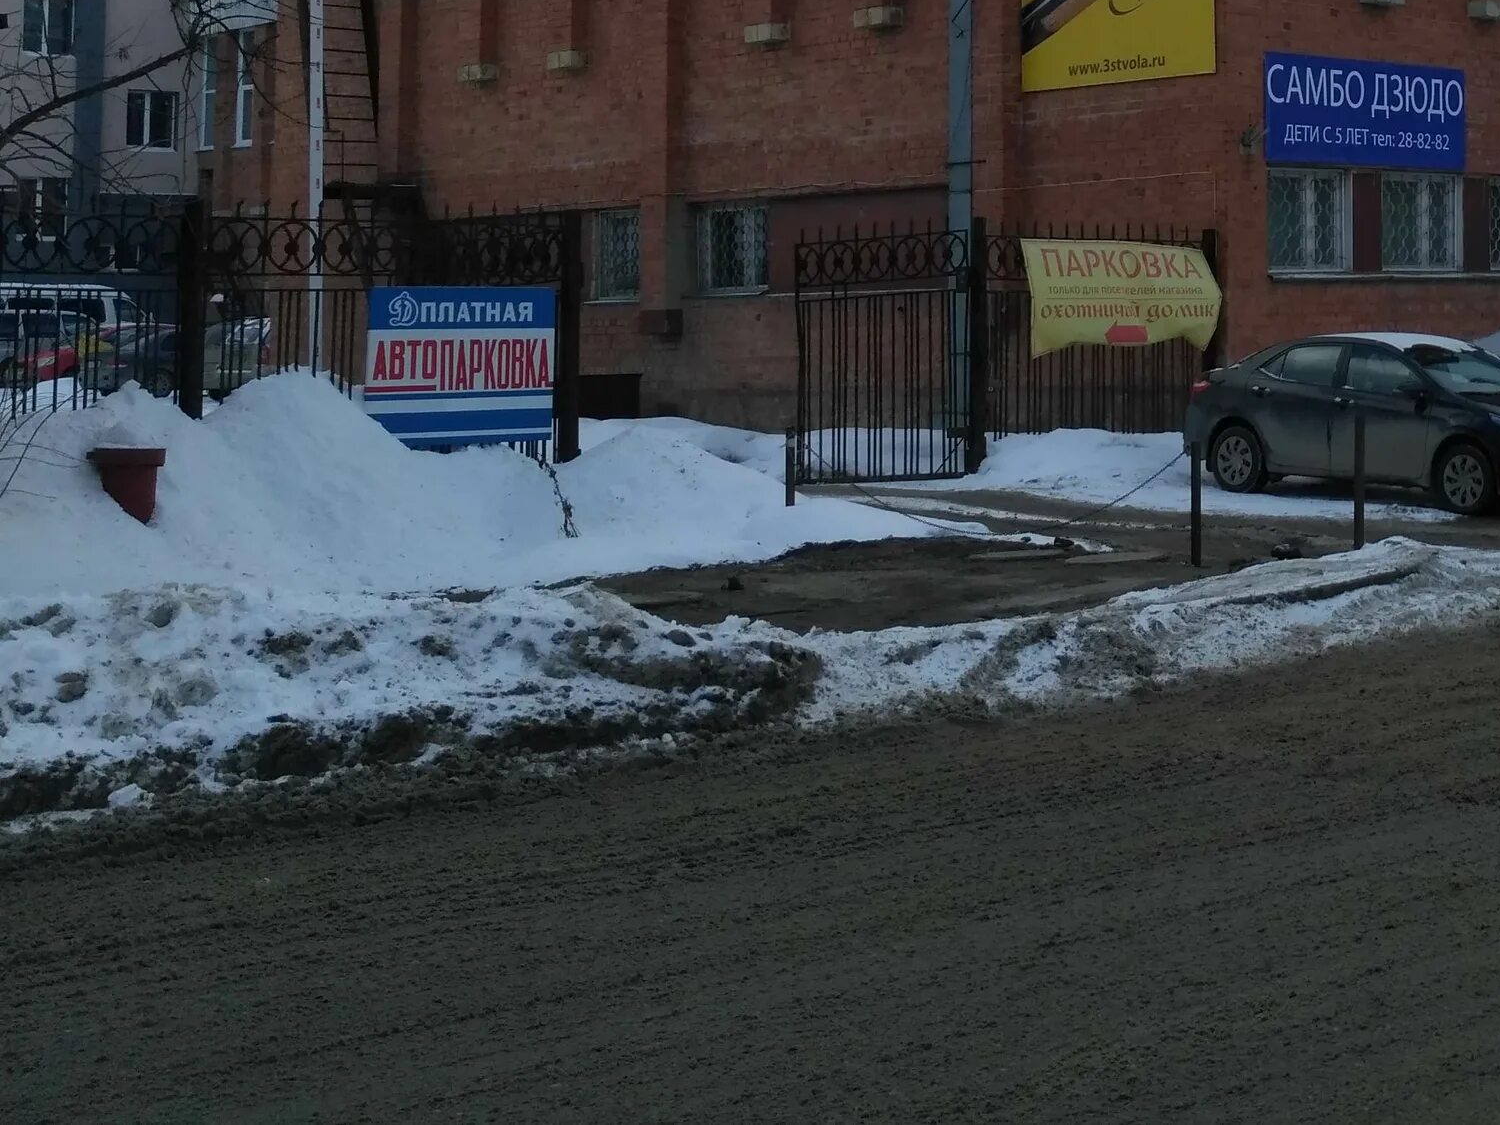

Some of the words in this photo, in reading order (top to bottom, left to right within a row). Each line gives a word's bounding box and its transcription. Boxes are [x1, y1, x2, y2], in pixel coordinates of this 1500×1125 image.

[1068, 53, 1166, 77] www.3stvola.ru
[1266, 63, 1365, 110] САМБО
[1370, 73, 1464, 124] ДЗЮДО
[1284, 124, 1320, 146] ДЕТИ
[1322, 126, 1333, 144] С
[1335, 127, 1343, 145] 5
[1345, 127, 1370, 147] ЛЕТ
[1371, 132, 1396, 148] тел:
[1397, 131, 1450, 151] 28-82-82
[1040, 248, 1203, 279] ПАРКОВКА
[1049, 284, 1081, 295] только
[1082, 285, 1100, 296] для
[1158, 285, 1204, 295] магазина
[420, 301, 534, 323] ПЛАТНАЯ
[372, 338, 551, 391] АВТОПАРКОВКА
